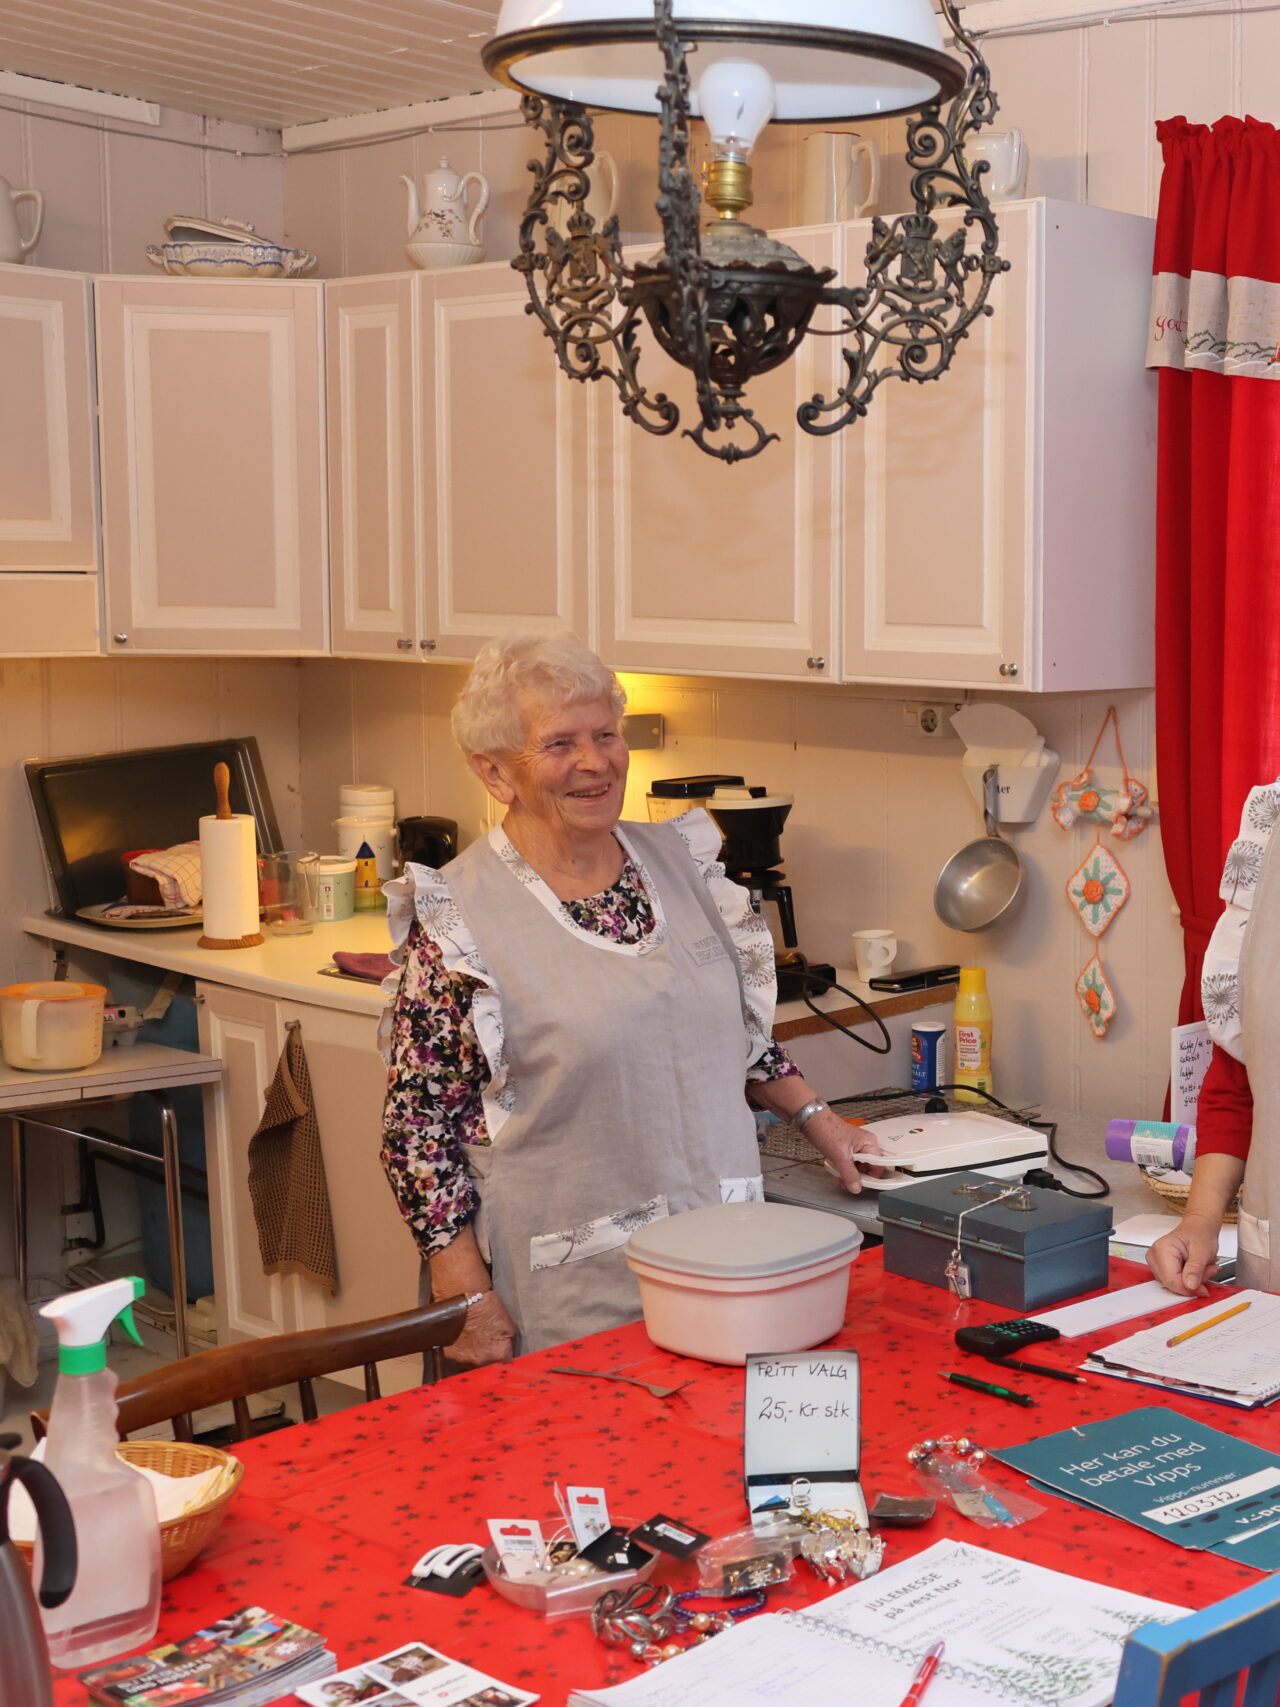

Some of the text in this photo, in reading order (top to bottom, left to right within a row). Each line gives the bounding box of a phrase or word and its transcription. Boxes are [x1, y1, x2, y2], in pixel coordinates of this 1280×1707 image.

[809, 1362, 848, 1380] VALG
[1059, 1433, 1182, 1476] Her kan du
[1079, 1442, 1207, 1487] betale med
[1133, 1462, 1202, 1488] Vipps
[865, 1572, 943, 1612] JULEMESSE
[884, 1607, 905, 1620] på
[904, 1592, 938, 1609] vest
[935, 1578, 963, 1594] Nor
